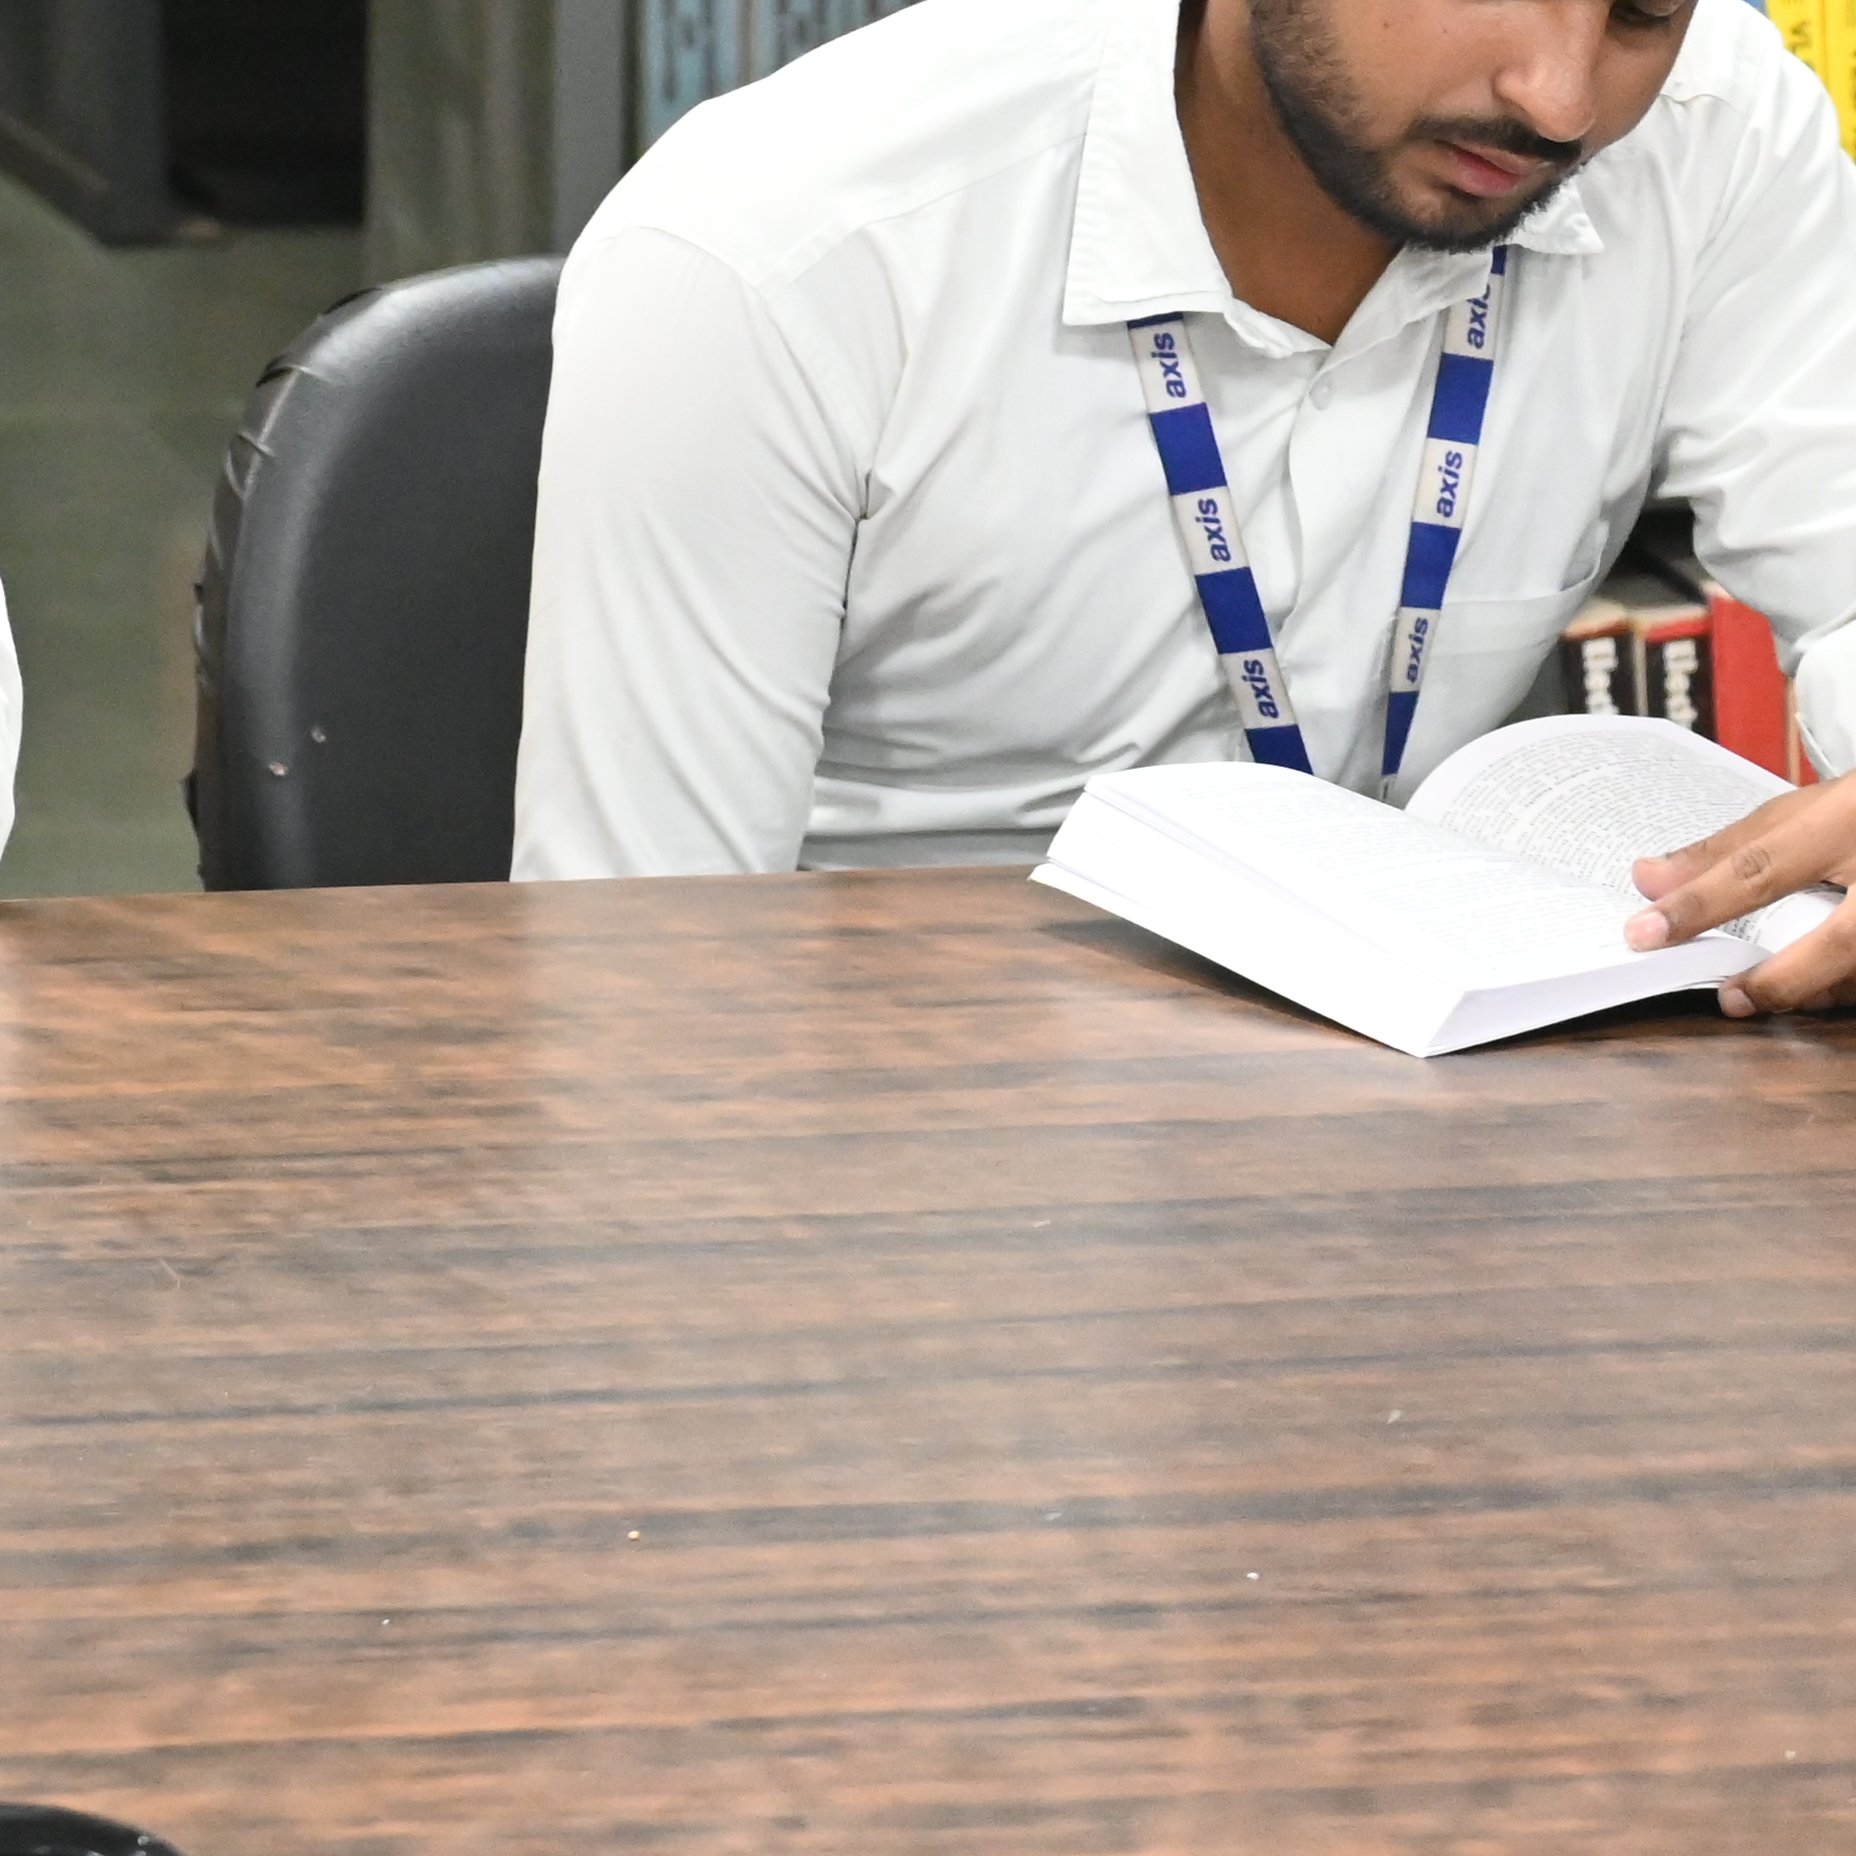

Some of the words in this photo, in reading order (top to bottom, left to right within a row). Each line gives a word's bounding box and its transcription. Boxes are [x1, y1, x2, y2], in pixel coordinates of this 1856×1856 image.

[1150, 331, 1188, 399] axis
[1436, 449, 1463, 518] axis
[1194, 497, 1232, 564] axis
[1405, 616, 1429, 684] axis
[1243, 658, 1279, 719] axis
